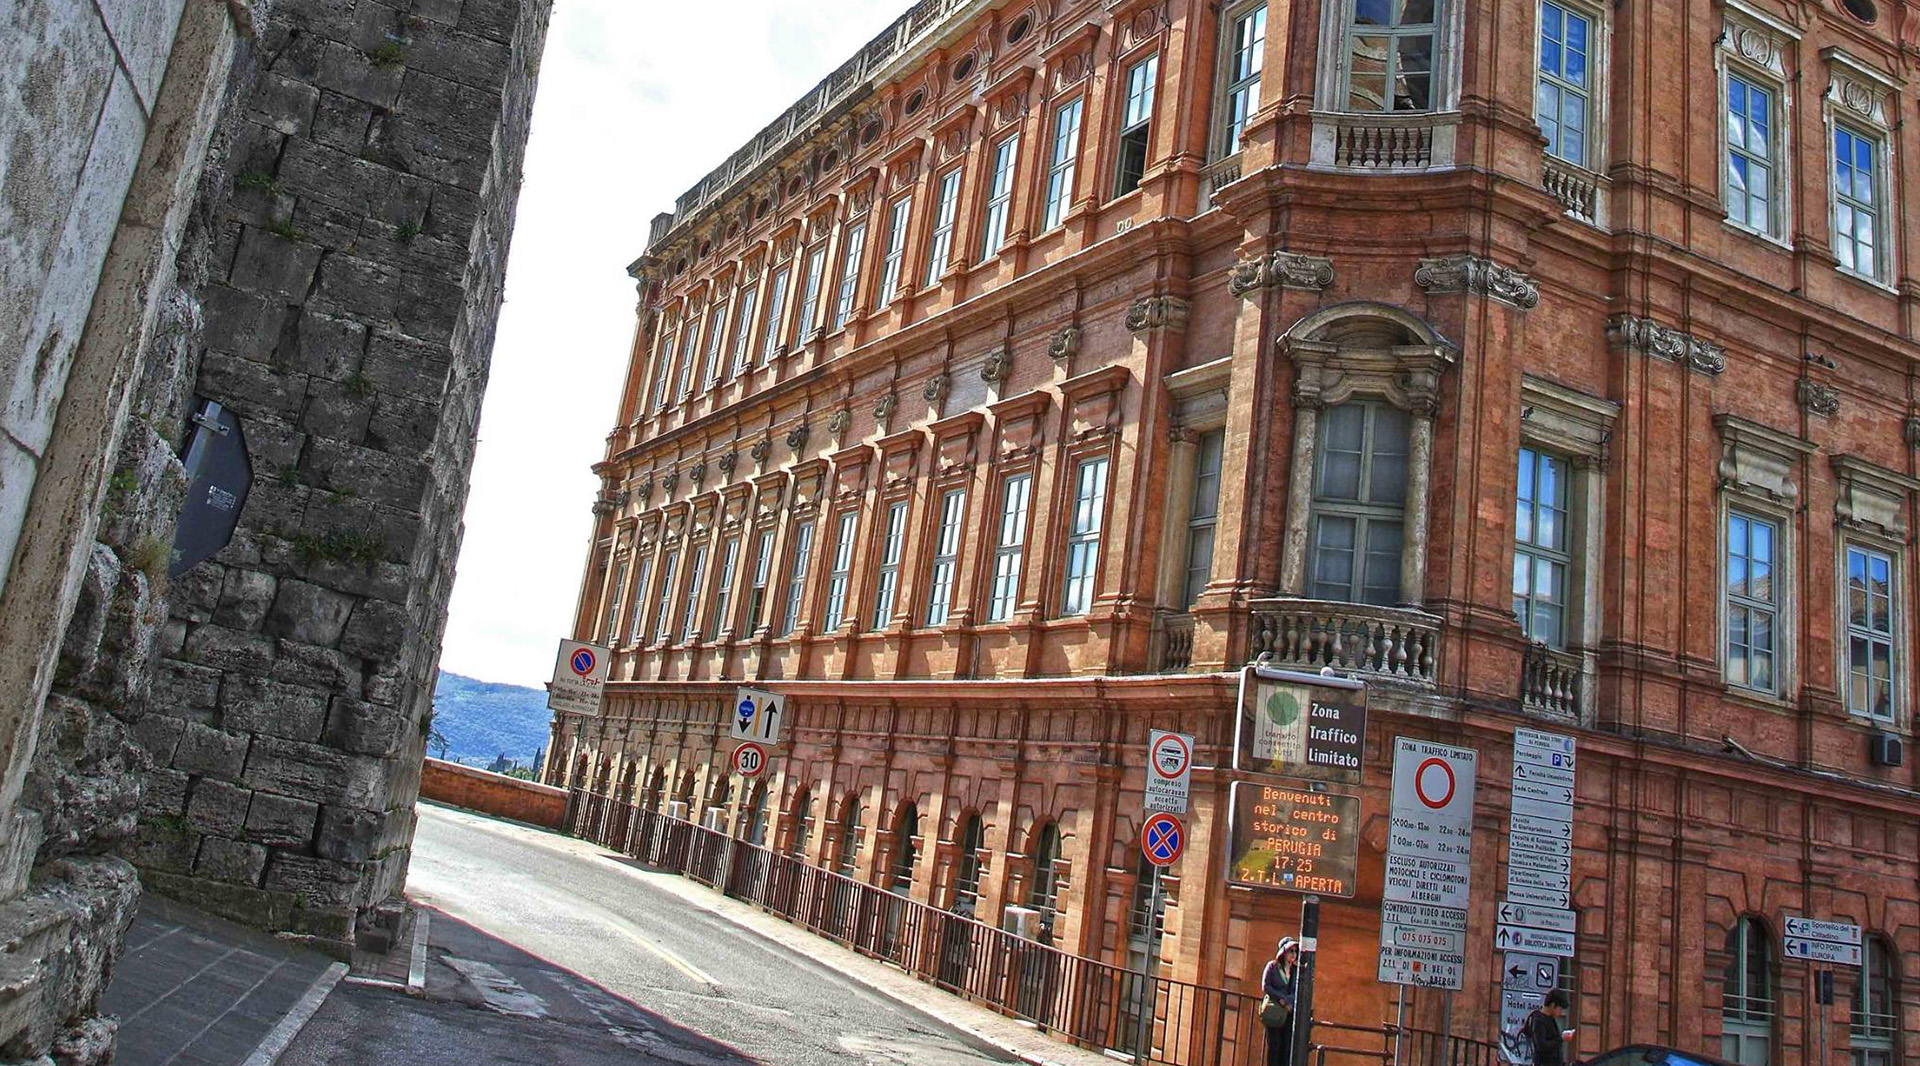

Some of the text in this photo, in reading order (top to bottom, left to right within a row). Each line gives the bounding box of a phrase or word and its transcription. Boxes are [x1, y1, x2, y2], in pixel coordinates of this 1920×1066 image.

[1312, 703, 1339, 719] Zona
[1310, 726, 1356, 744] Traffico
[1308, 748, 1358, 767] Limitato
[1402, 742, 1473, 761] ZONA TRAFFICO LIMITATO
[741, 752, 758, 769] 30
[1154, 778, 1182, 787] compreso
[1148, 786, 1185, 796] autocaravan
[1263, 787, 1331, 806] Benvenuti
[1528, 787, 1548, 795] Centrale
[1254, 805, 1339, 824] nel centro
[1254, 821, 1337, 840] storico di
[1265, 837, 1321, 856] PERUGIA
[1274, 856, 1312, 872] 17:25
[1390, 856, 1456, 872] ESCLUSO AUTORIZZATI
[1389, 867, 1419, 878] MOTOCICLI
[1430, 873, 1467, 884] CICLOMOTORI
[1295, 875, 1342, 893] APERTA
[1389, 877, 1456, 893] VEICOLI DIRETTI AGLI
[1411, 891, 1441, 902] ALBERGHI
[1384, 903, 1465, 920] CONTROLLO VIDEO ACCESSI
[1812, 922, 1838, 931] Sportello
[1402, 933, 1446, 946] 075 075 075
[1811, 931, 1838, 940] Cittadino
[1381, 946, 1462, 963] PER INFORMAZIONI ACCESSI
[1812, 952, 1835, 960] EUROPA
[1508, 1000, 1525, 1009] Hotel
